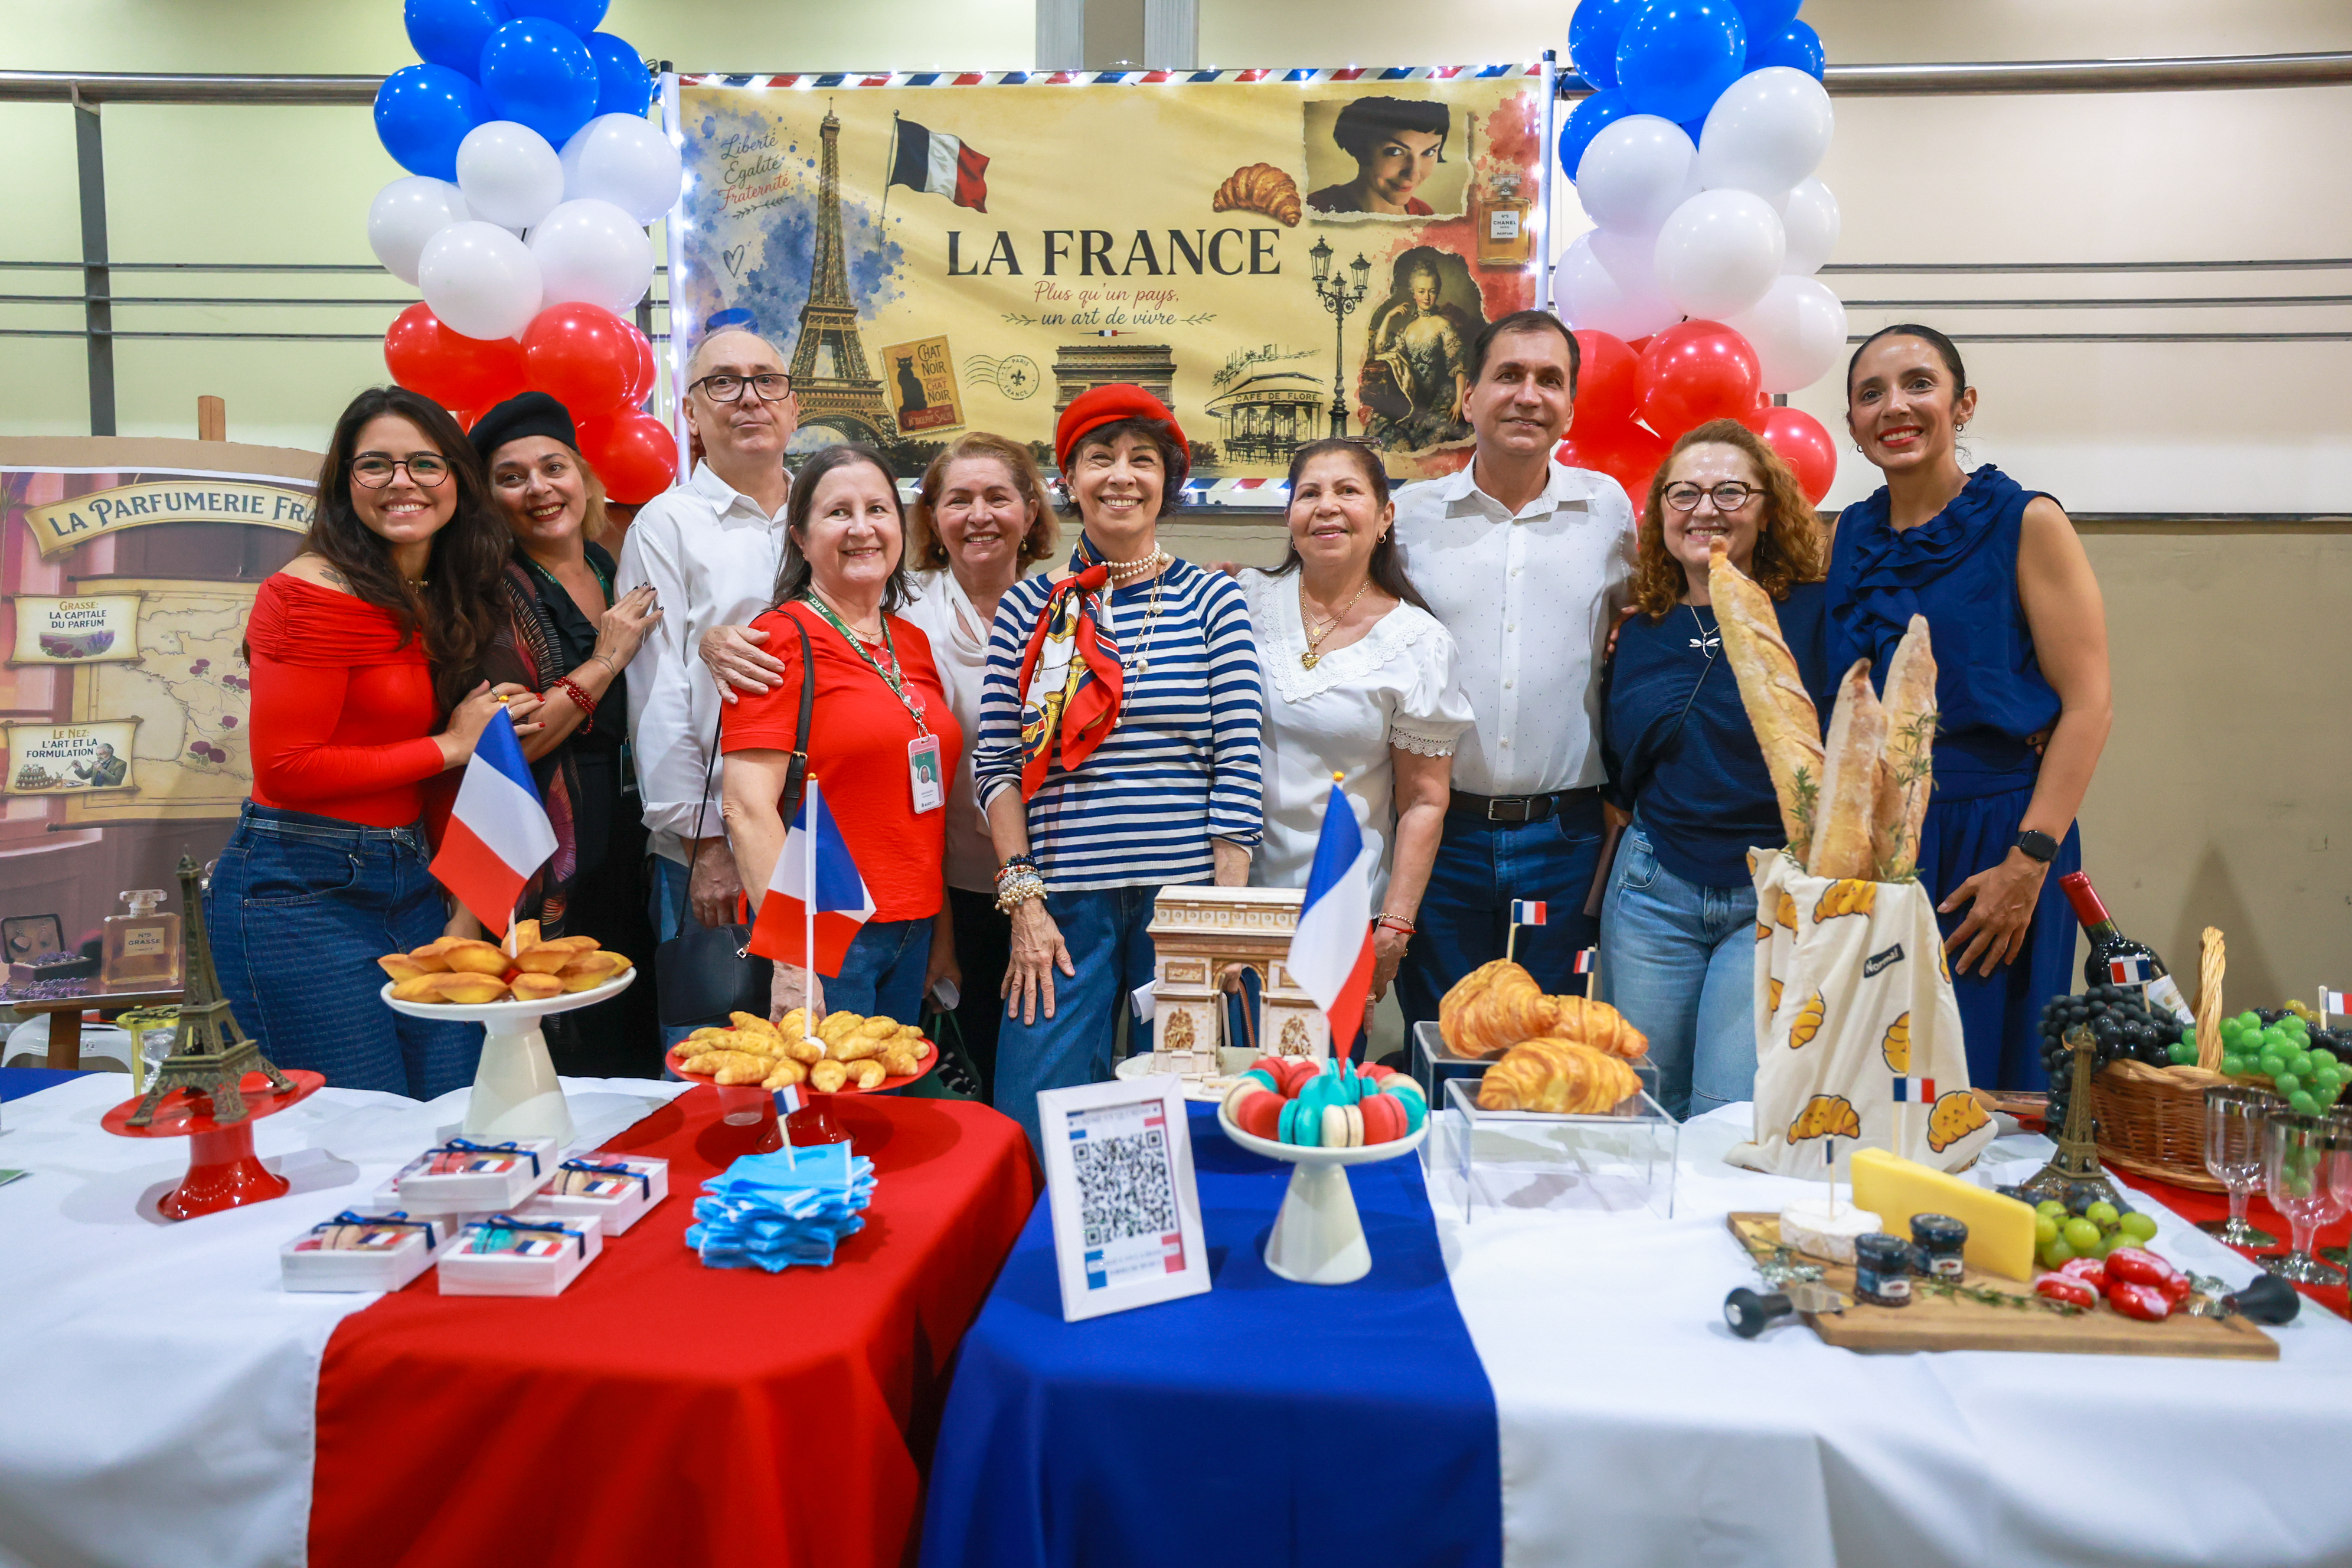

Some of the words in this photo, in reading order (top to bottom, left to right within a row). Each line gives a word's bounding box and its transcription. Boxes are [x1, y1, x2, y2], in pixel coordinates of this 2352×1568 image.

[720, 128, 779, 160] Liberté
[717, 170, 791, 210] Fraternité
[946, 230, 1024, 276] LA
[1042, 228, 1280, 276] FRANCE
[1034, 281, 1073, 303] Plus
[1079, 283, 1130, 309] qu'un
[1133, 288, 1180, 309] pays,
[1041, 313, 1065, 326] un
[1072, 308, 1100, 325] art
[1105, 306, 1126, 325] de
[1133, 310, 1177, 325] vivre
[917, 344, 941, 362] CHAT
[926, 381, 947, 391] CHAT
[1004, 385, 1028, 397] FRANCE
[927, 390, 952, 403] NOIR
[1236, 393, 1262, 402] CAFÉ
[1288, 392, 1318, 401] FLORE
[48, 512, 89, 537] LA
[89, 492, 265, 528] PARFUMERIE
[60, 601, 99, 611] GRASSE:
[809, 597, 829, 613] ALECE
[64, 610, 107, 619] CAPITALE
[68, 619, 104, 628] PARFUM
[847, 634, 866, 654] ALECE
[53, 729, 64, 740] LE
[68, 729, 90, 739] NEZ:
[42, 740, 70, 749] L'ART
[73, 739, 84, 747] ET
[87, 738, 98, 746] LA
[27, 748, 94, 758] FORMULATION
[1865, 947, 1899, 974] Normal
